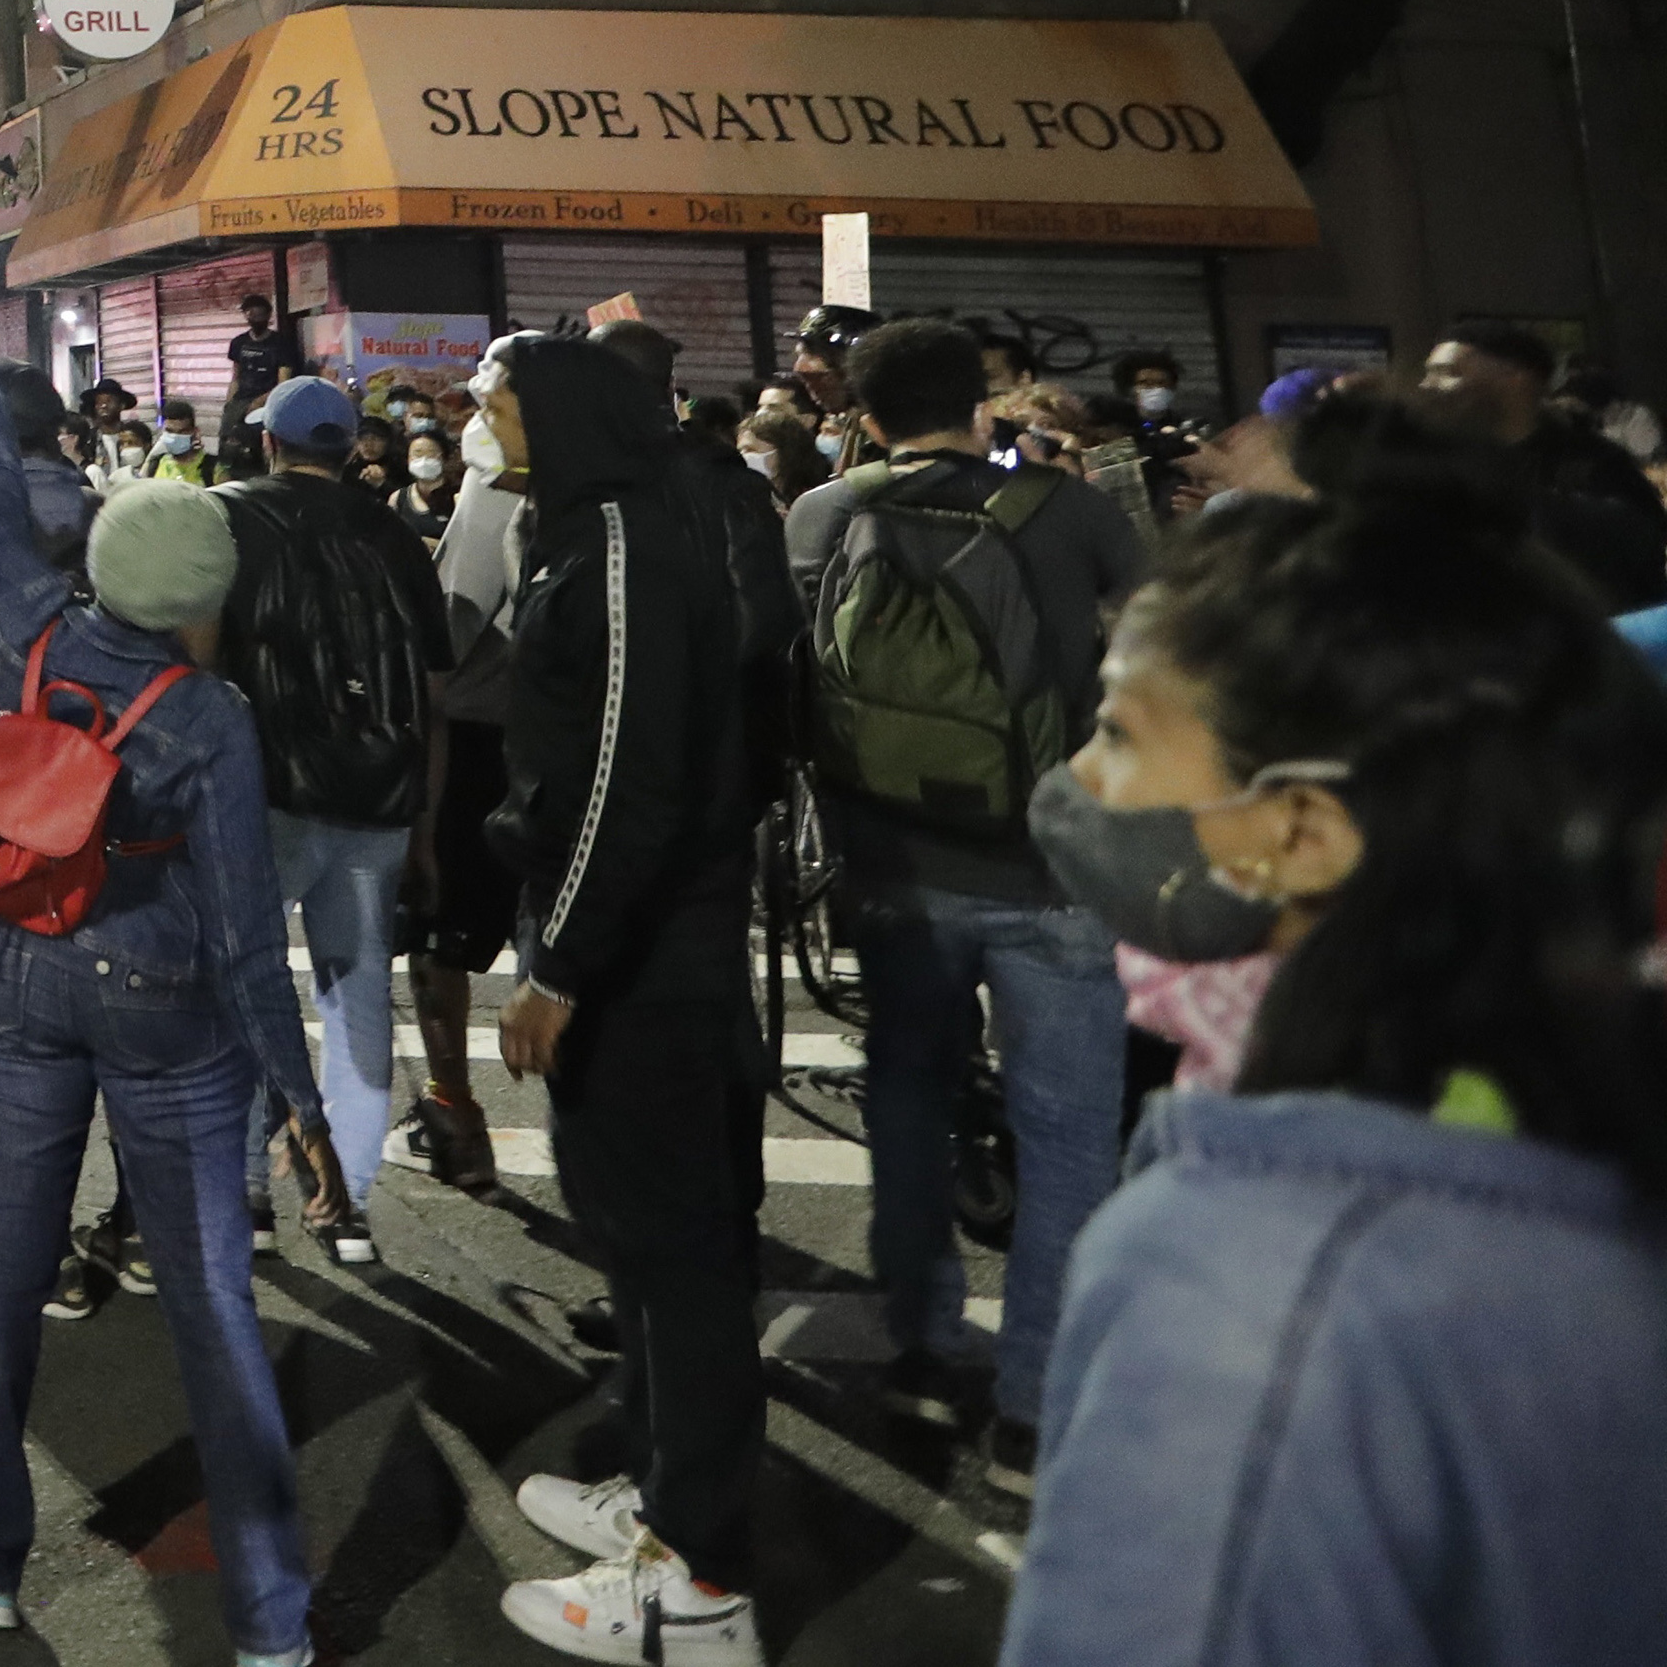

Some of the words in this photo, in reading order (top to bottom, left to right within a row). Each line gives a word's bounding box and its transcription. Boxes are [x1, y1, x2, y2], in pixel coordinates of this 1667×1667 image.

[64, 10, 151, 32] GRILL
[270, 78, 341, 125] 24
[421, 87, 640, 139] SLOPE
[643, 90, 1006, 148] NATURAL
[1014, 99, 1226, 154] FOOD
[254, 127, 345, 162] HRS
[209, 203, 265, 229] Fruits
[284, 197, 387, 227] Vegetables
[450, 194, 546, 221] Frozen
[553, 196, 625, 222] Food
[685, 198, 745, 224] Deli
[361, 336, 429, 356] Natural
[436, 338, 481, 357] Food
